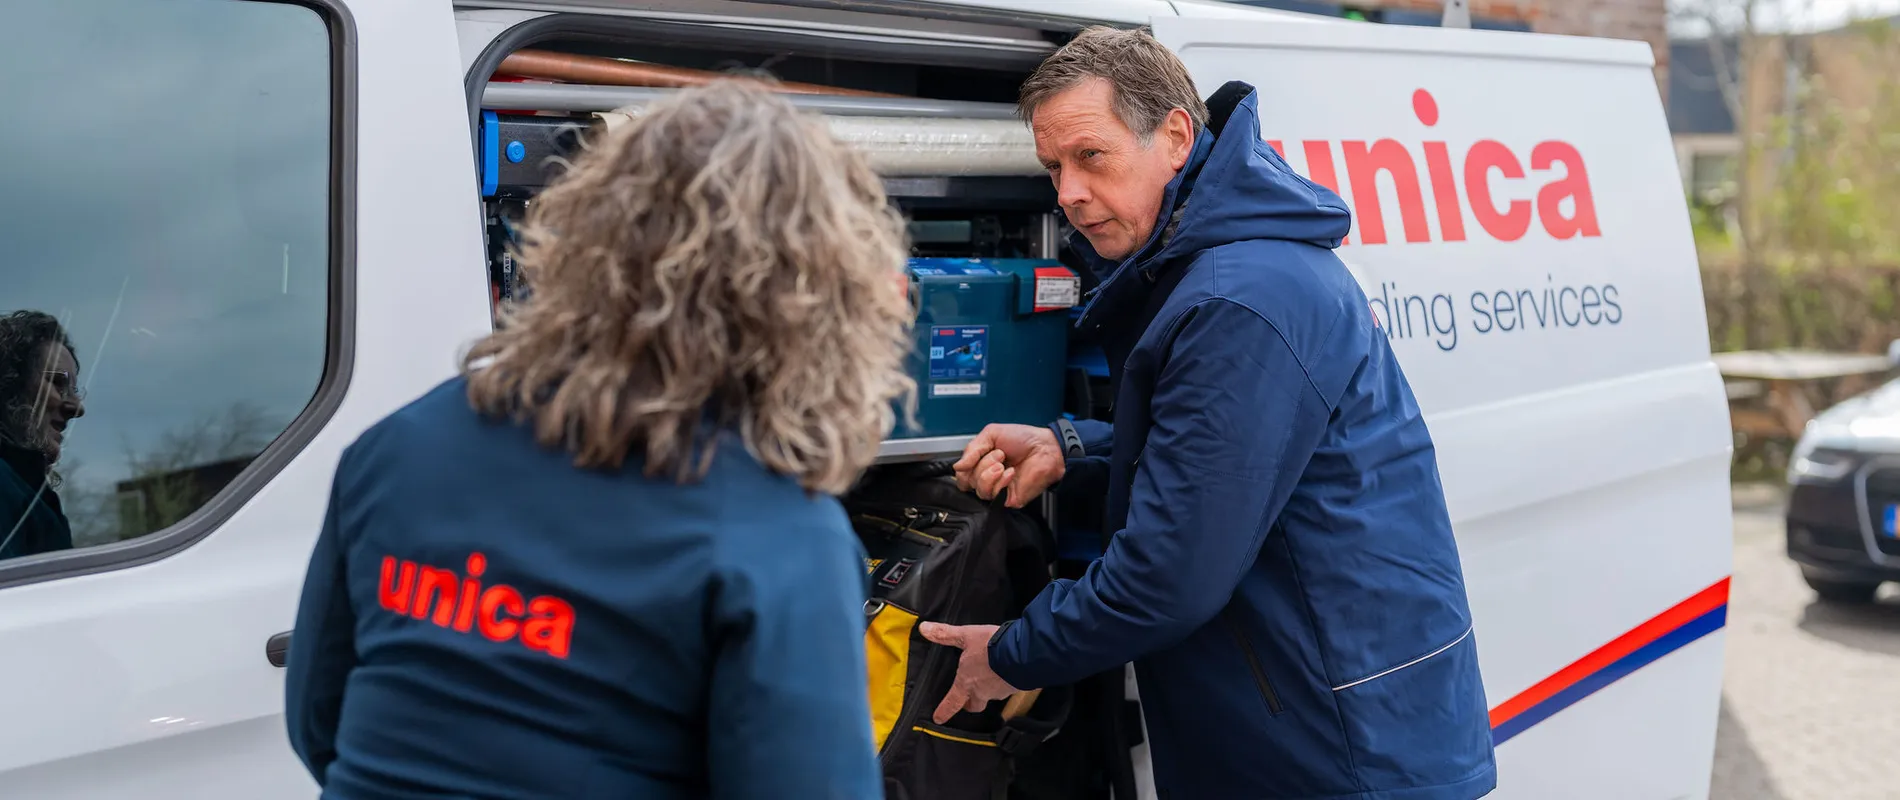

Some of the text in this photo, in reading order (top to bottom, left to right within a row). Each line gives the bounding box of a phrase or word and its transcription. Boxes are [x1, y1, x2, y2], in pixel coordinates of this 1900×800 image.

[1370, 274, 1623, 352] ding services
[377, 552, 576, 660] unica
